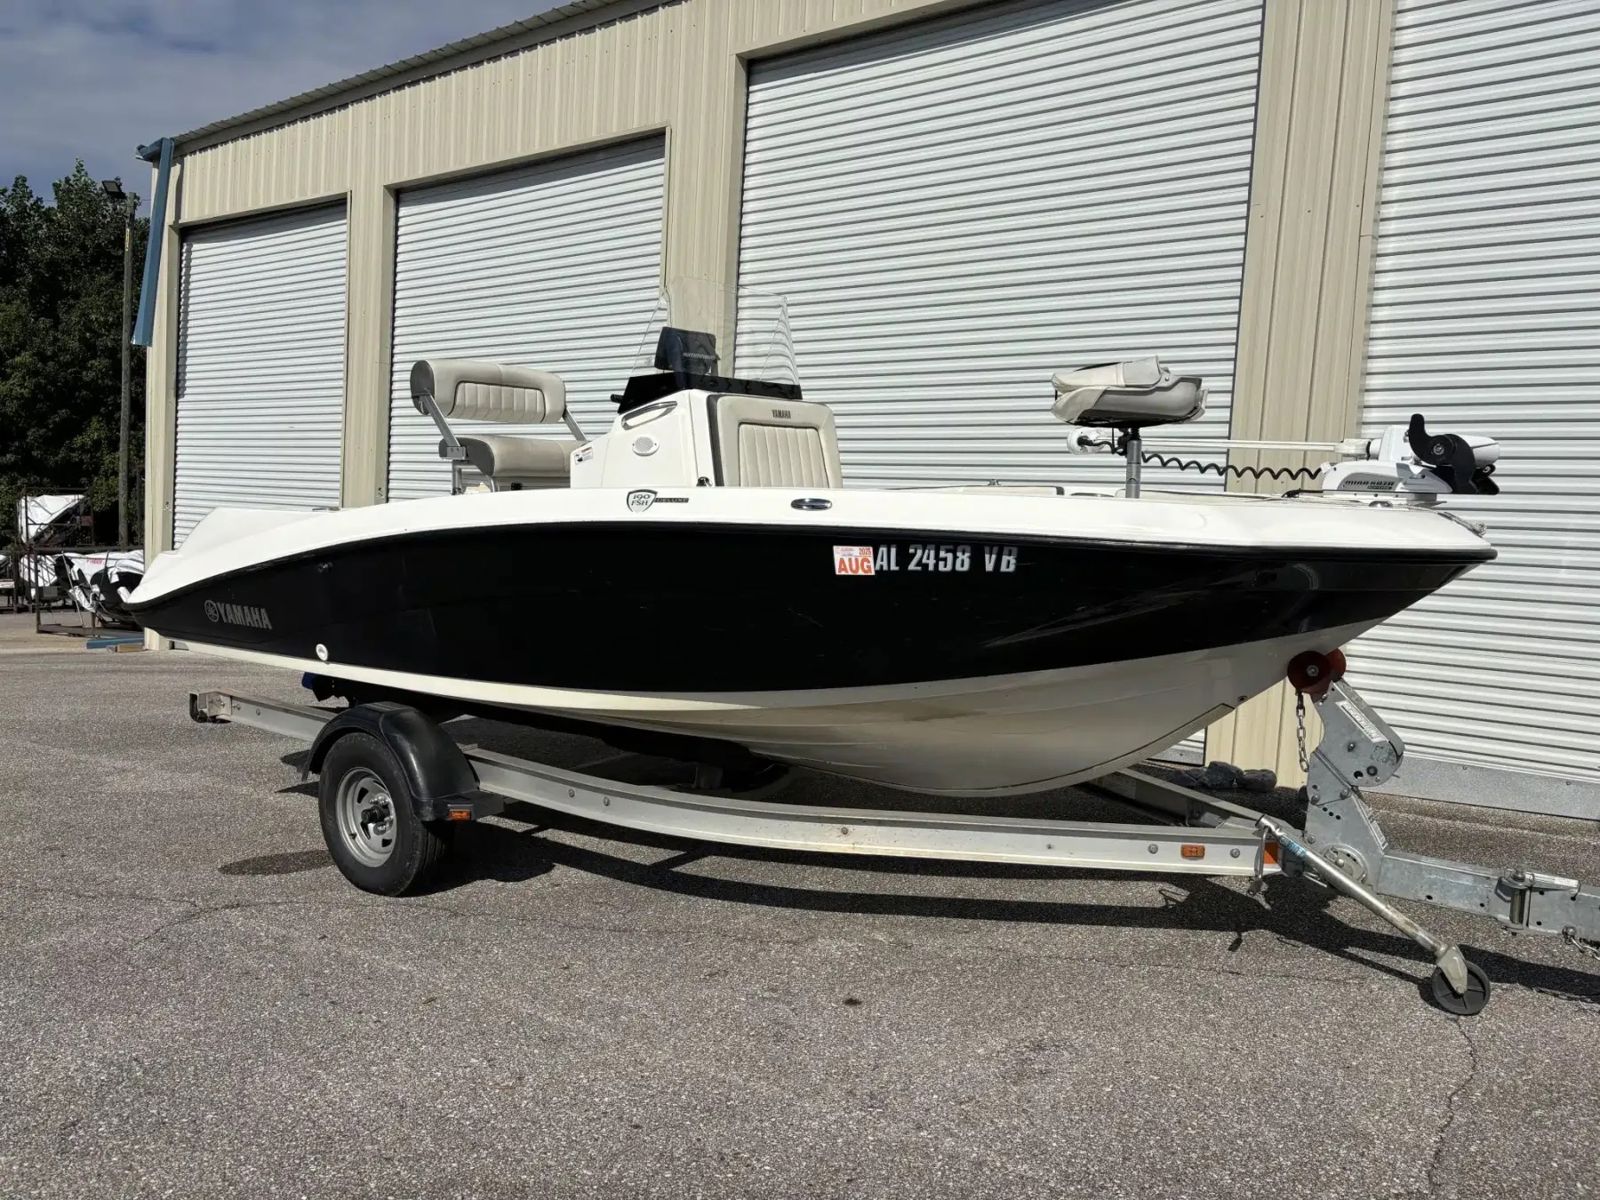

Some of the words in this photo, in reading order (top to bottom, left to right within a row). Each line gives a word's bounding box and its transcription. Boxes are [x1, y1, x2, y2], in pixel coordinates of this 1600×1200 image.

[771, 409, 791, 418] YAMAHA
[837, 557, 873, 574] AUG
[875, 544, 899, 571] AL
[907, 544, 971, 572] 2458
[984, 546, 1018, 573] VB
[216, 601, 272, 630] YAMAHA
